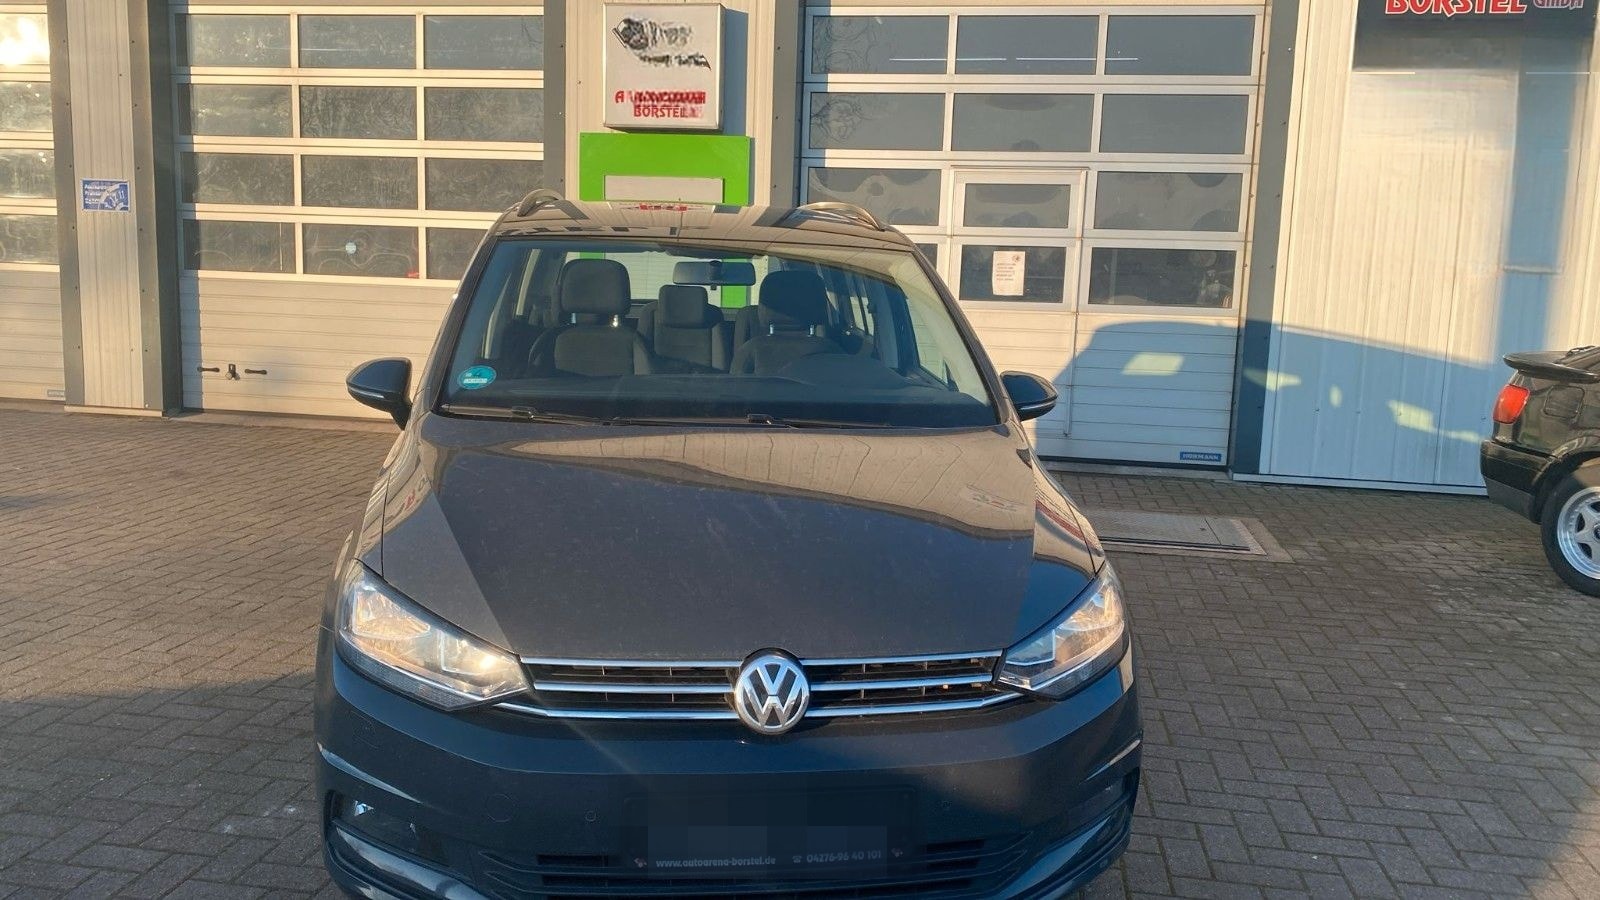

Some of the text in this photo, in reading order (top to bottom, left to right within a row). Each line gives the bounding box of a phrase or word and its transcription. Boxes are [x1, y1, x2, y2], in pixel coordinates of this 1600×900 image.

[738, 656, 806, 732] VW
[655, 857, 776, 867] www.autoarena-borstel.de
[851, 850, 865, 860] 40
[867, 849, 881, 859] 101
